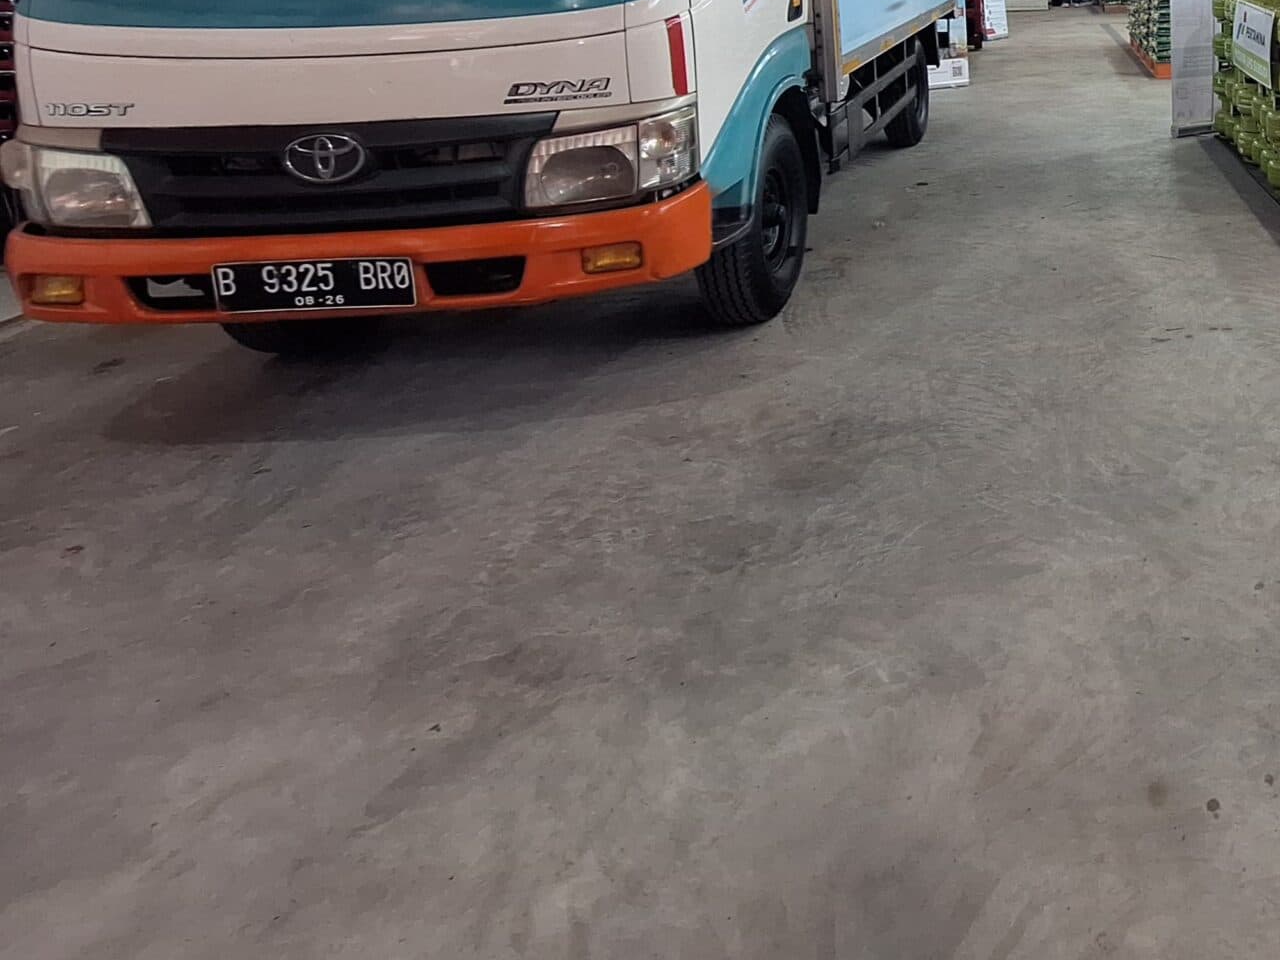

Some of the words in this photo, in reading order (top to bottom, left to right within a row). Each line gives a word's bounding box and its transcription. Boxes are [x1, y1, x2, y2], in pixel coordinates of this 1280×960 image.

[507, 77, 610, 96] DYNA
[216, 267, 236, 296] B
[262, 263, 334, 293] 9325
